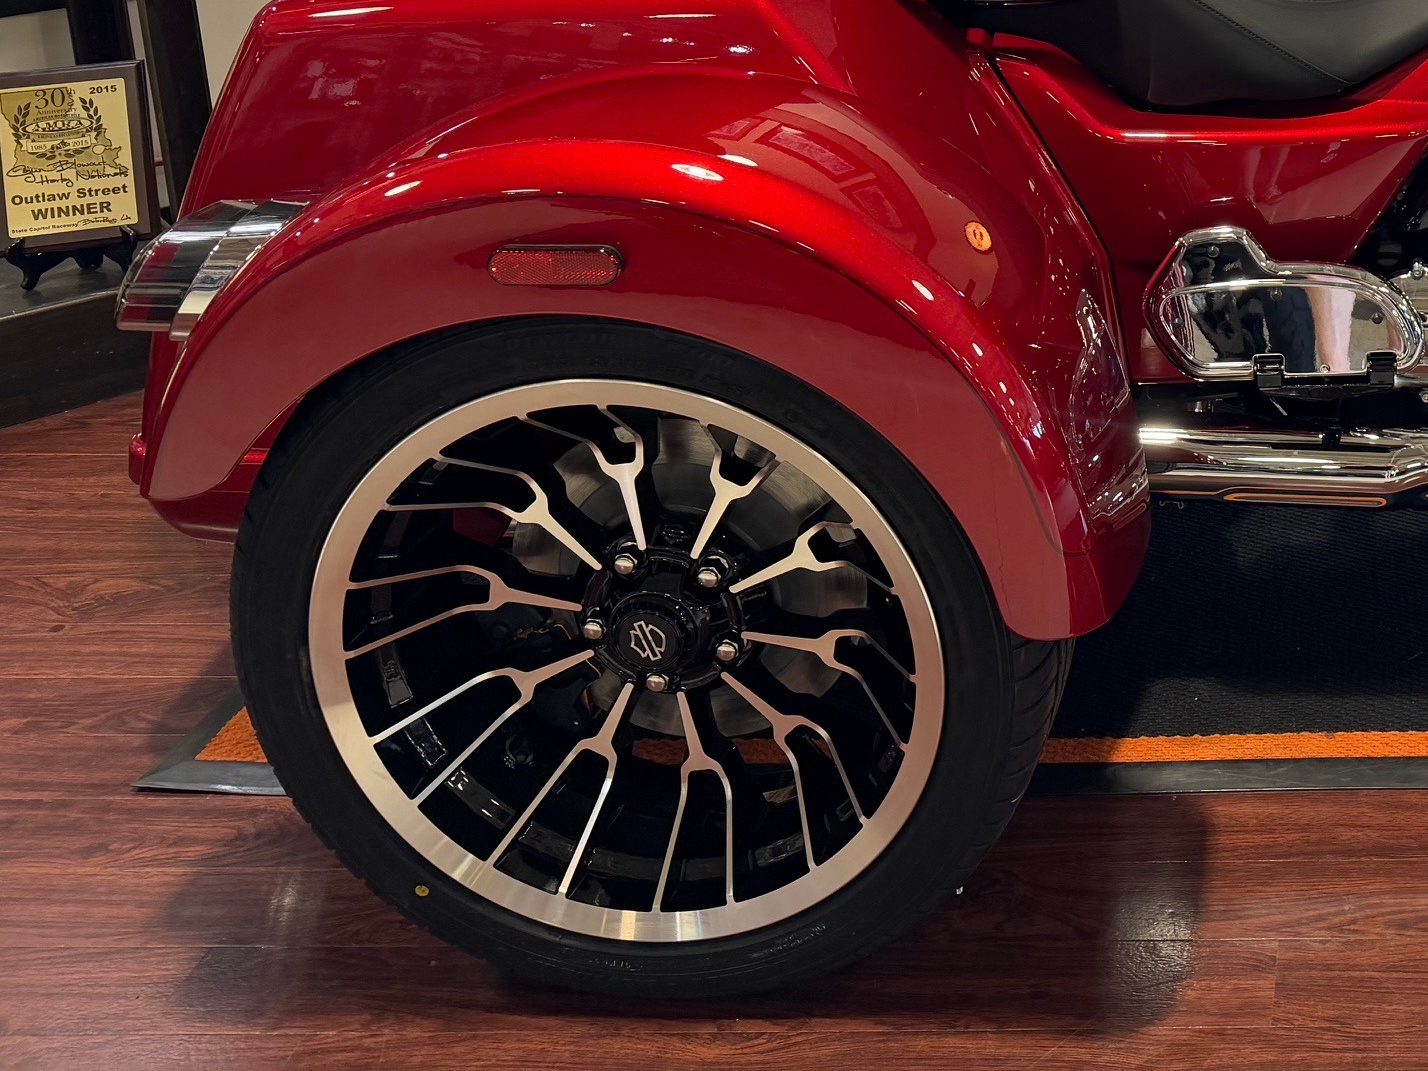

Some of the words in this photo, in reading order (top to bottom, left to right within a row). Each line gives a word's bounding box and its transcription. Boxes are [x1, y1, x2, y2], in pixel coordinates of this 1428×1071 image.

[89, 84, 118, 95] 2015
[30, 143, 48, 151] 1985
[71, 139, 89, 147] 2015
[11, 190, 71, 206] Outlaw
[76, 182, 129, 199] Street
[31, 200, 113, 221] WINNER
